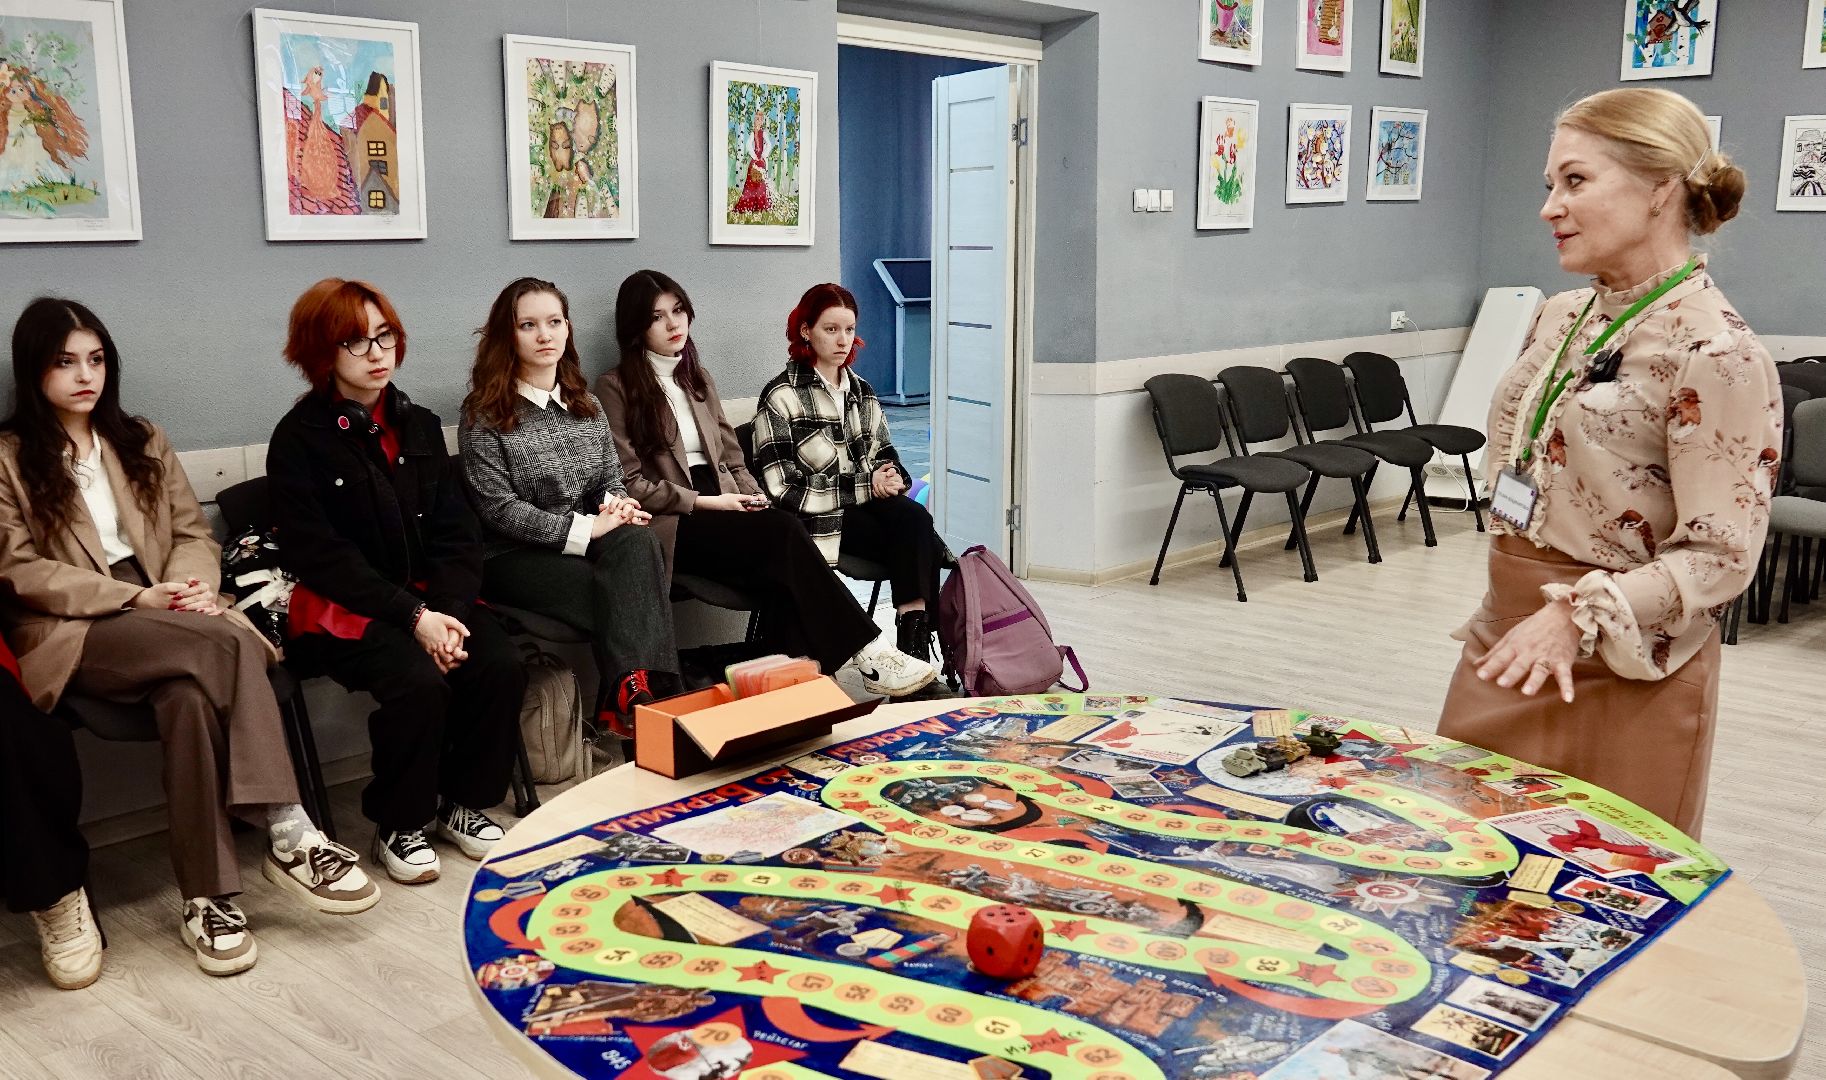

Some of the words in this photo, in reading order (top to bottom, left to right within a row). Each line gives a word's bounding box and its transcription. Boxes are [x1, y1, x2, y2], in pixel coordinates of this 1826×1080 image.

[867, 811, 889, 820] 23
[920, 827, 942, 838] 24
[949, 836, 971, 844] 25
[986, 842, 1008, 851] 26
[1026, 849, 1045, 857] 27
[1060, 855, 1084, 864] 28
[1105, 864, 1126, 874] 29
[618, 876, 637, 886] 49
[752, 876, 770, 884] 47
[1145, 874, 1170, 886] 30
[575, 889, 601, 899] 50
[559, 908, 582, 916] 51
[556, 926, 581, 934] 52
[1328, 919, 1358, 931] 34
[567, 941, 595, 953] 53
[604, 950, 630, 961] 54
[647, 955, 673, 966] 55
[694, 960, 719, 972] 56
[1257, 960, 1279, 971] 38
[801, 975, 826, 989] 57
[845, 985, 870, 999] 58
[888, 996, 914, 1011] 59
[936, 1007, 963, 1023] 60
[984, 1018, 1011, 1035] 61
[701, 1028, 730, 1041] 70
[1084, 1048, 1118, 1063] 62
